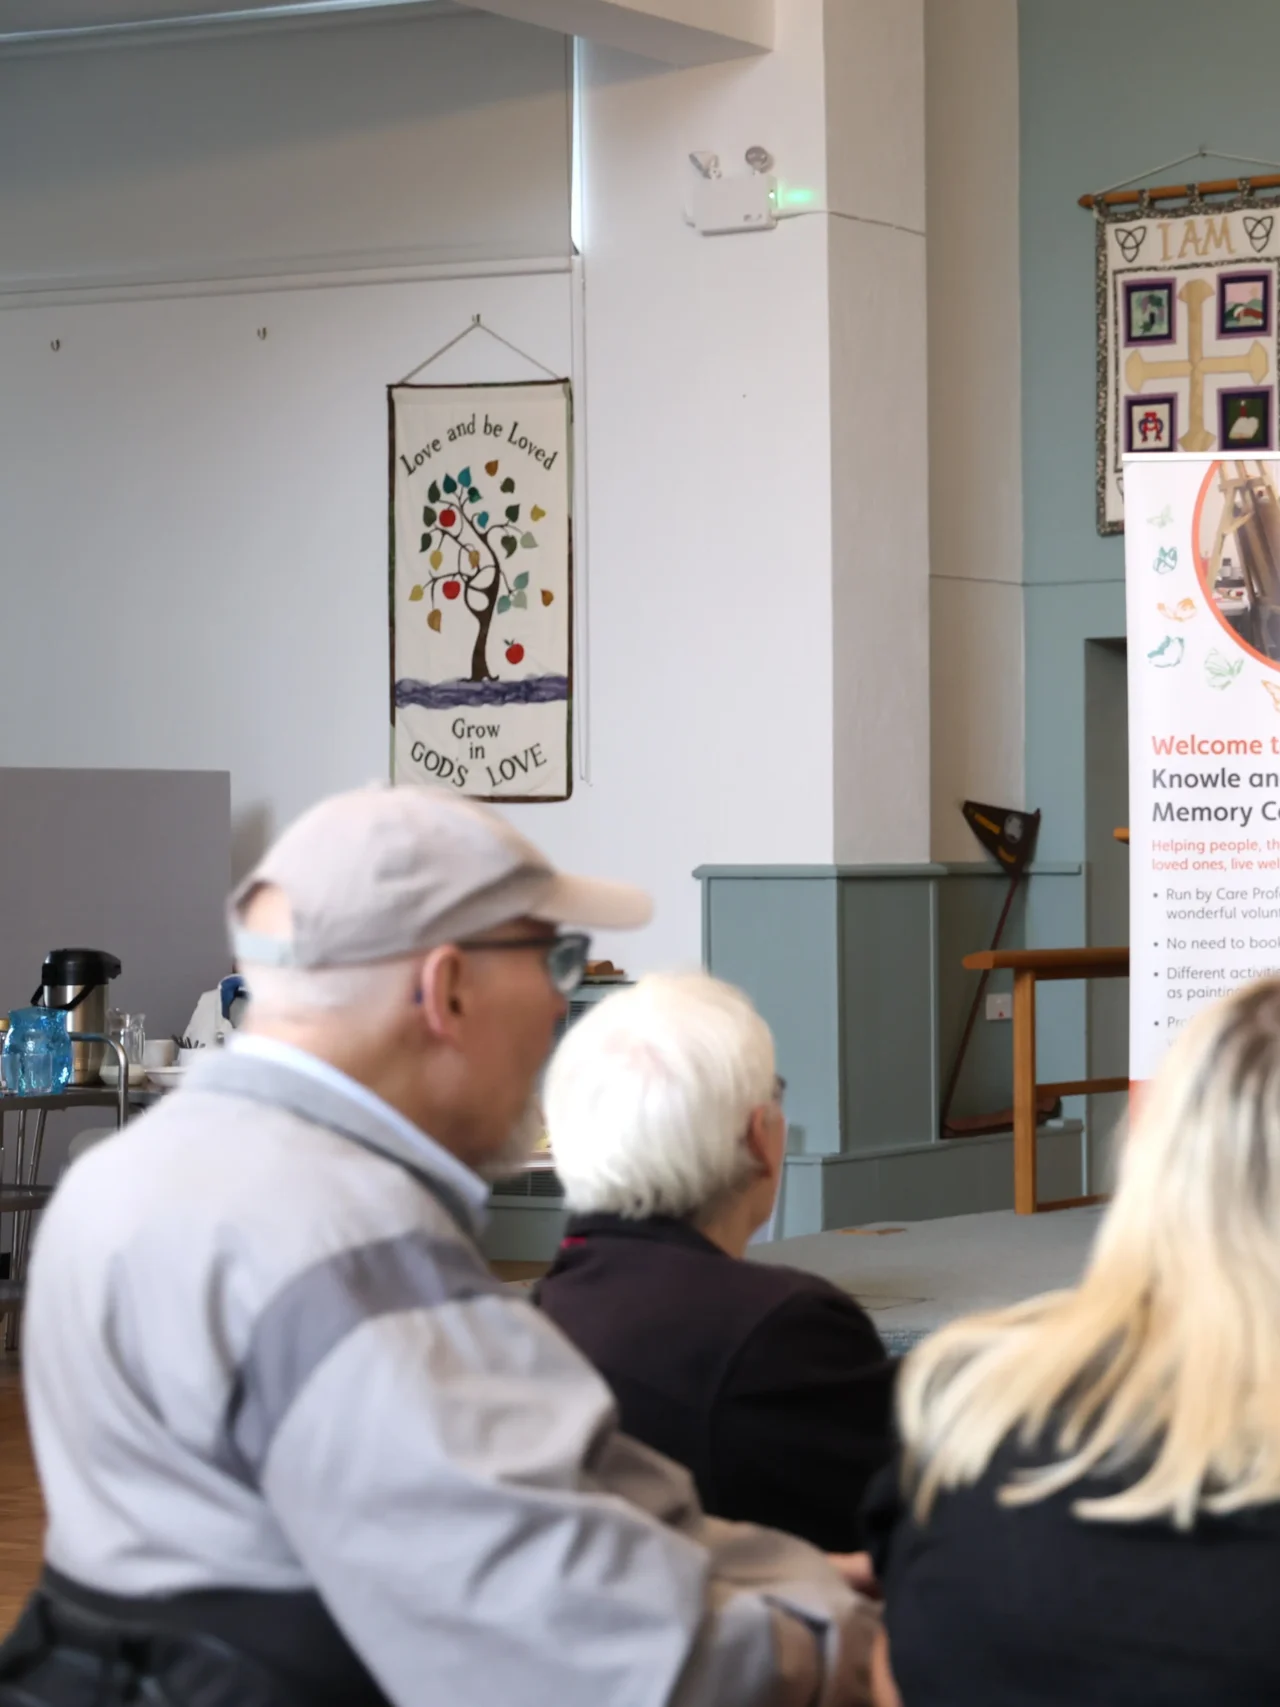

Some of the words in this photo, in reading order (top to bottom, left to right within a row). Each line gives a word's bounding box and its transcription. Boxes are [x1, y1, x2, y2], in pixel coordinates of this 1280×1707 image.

[1156, 221, 1173, 263] I
[1177, 215, 1237, 260] AM
[399, 438, 442, 476] Love
[447, 412, 476, 443] and
[483, 413, 503, 438] be
[507, 421, 559, 471] Loved
[451, 717, 500, 740] Grow
[469, 742, 485, 760] in
[1151, 734, 1263, 756] Welcome
[485, 743, 548, 787] LOVE
[1151, 767, 1241, 789] Knowle
[1151, 801, 1253, 827] Memory
[1151, 839, 1205, 854] Helping
[1209, 839, 1262, 854] people,
[1151, 858, 1189, 871] loved
[1192, 858, 1227, 872] ones,
[1230, 858, 1253, 870] live
[1165, 888, 1192, 901] Run
[1195, 888, 1212, 904] by
[1216, 887, 1248, 901] Care
[1166, 907, 1237, 920] wonderful
[1166, 937, 1187, 950] No
[1191, 937, 1226, 950] need
[1230, 938, 1245, 949] to
[1166, 966, 1226, 980] Different
[1166, 988, 1183, 999] as
